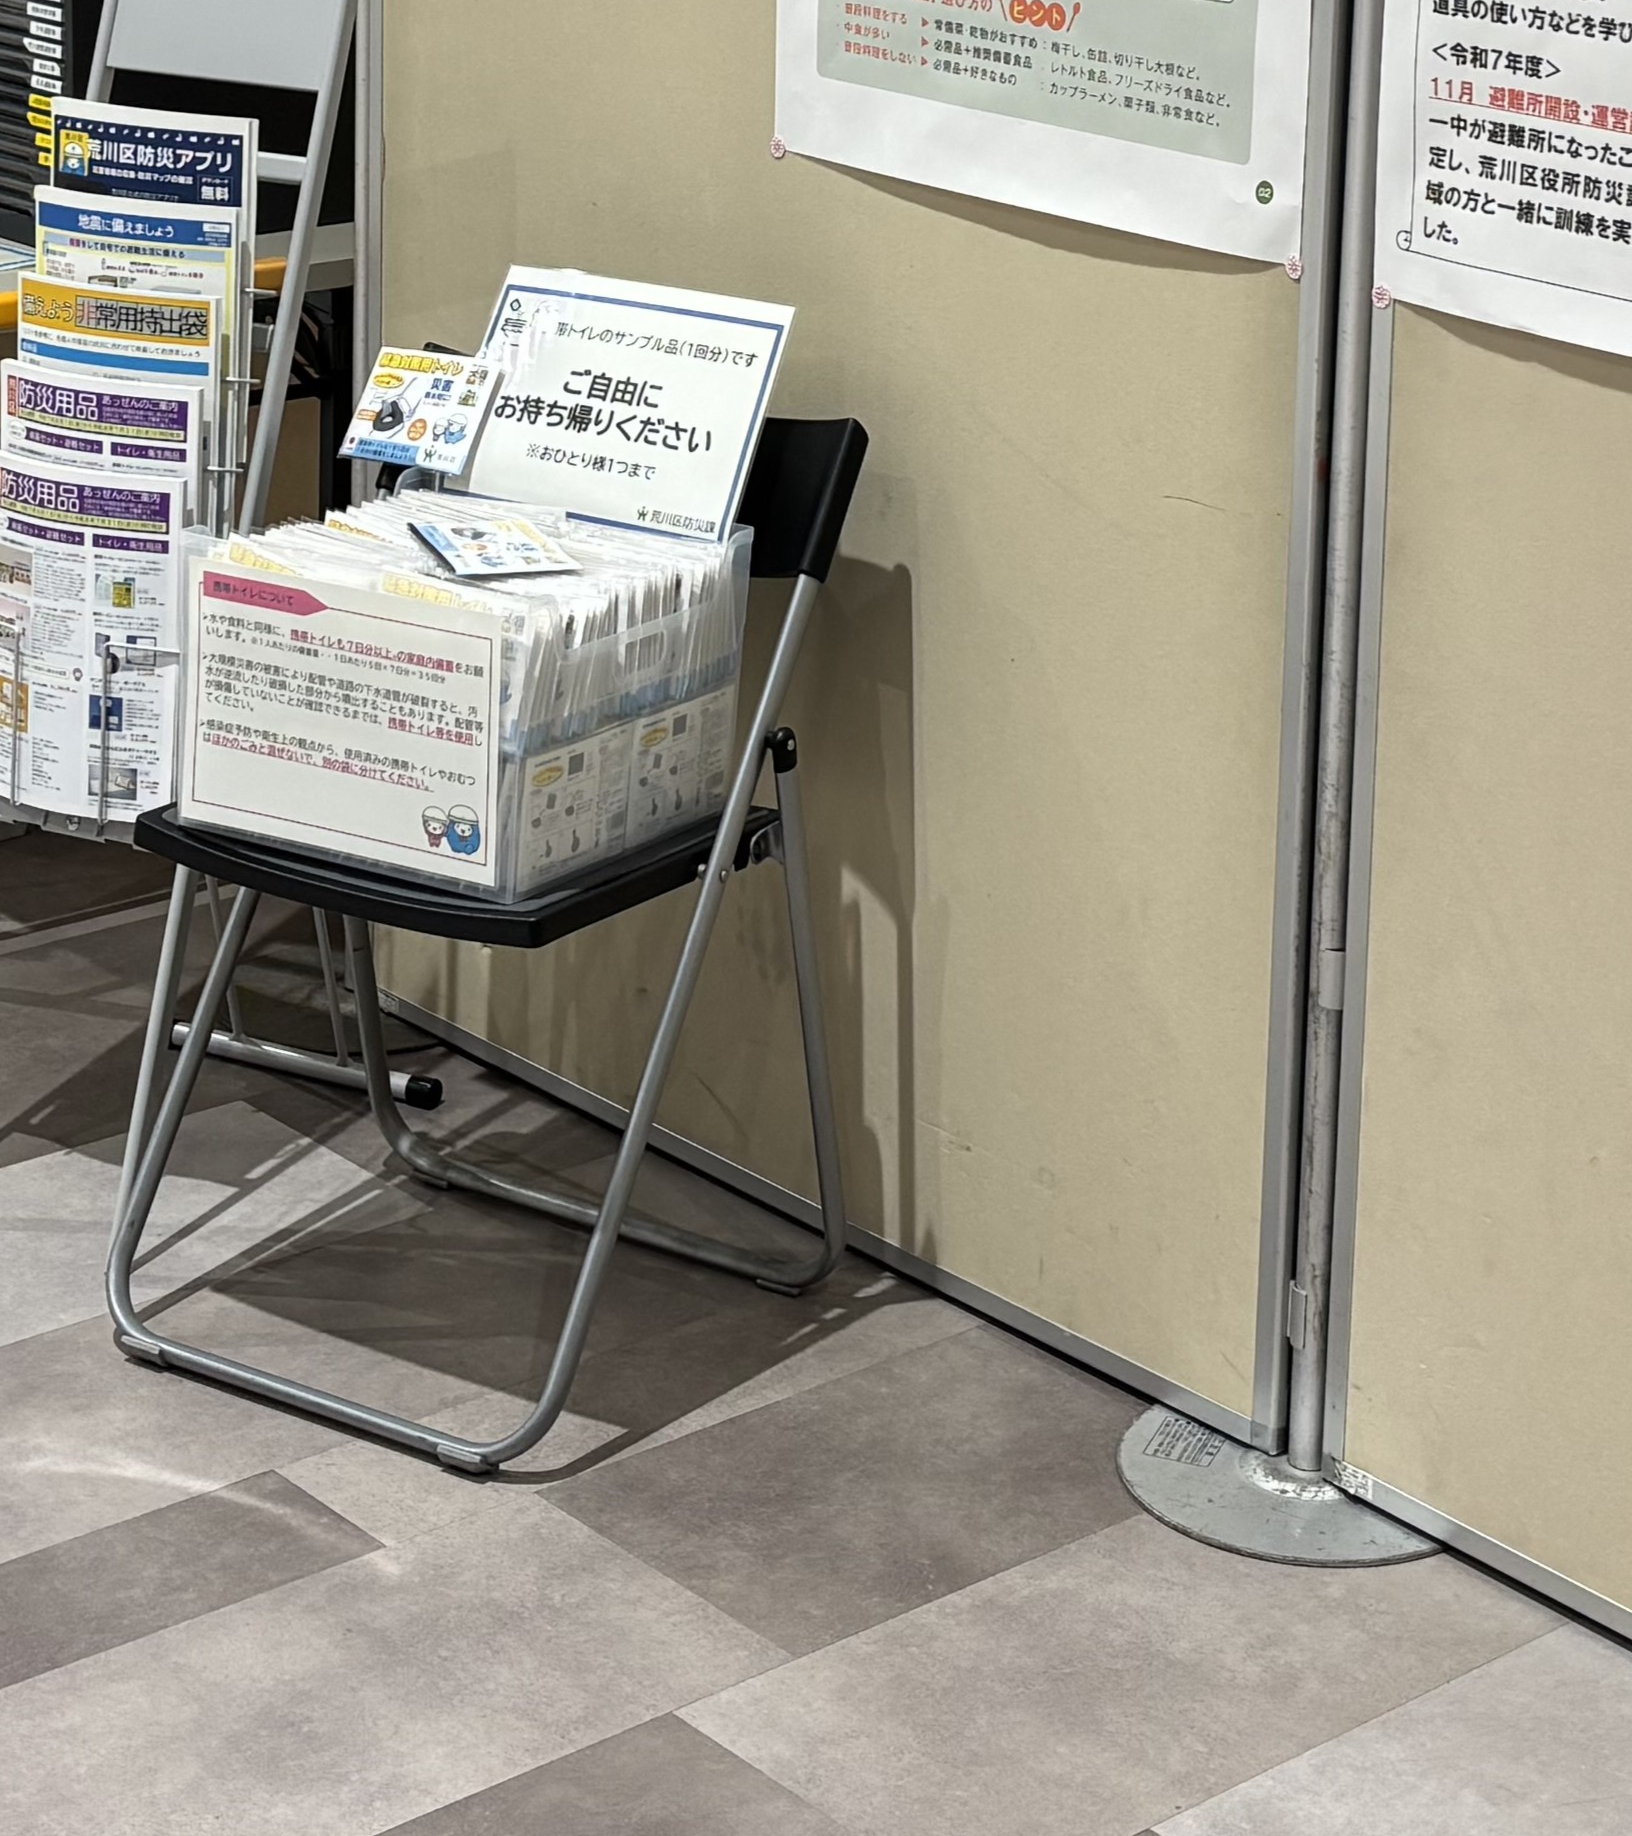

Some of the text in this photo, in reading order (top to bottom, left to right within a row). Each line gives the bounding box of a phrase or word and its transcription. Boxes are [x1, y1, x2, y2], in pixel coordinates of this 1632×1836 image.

[1013, 2, 1064, 27] ヒント
[87, 139, 232, 172] 荒川区防災アプリ
[201, 186, 229, 201] 無料
[78, 214, 174, 237] 地震に備えましょう
[76, 298, 209, 338] 非常用持出袋
[19, 380, 98, 420] 防災用品
[102, 396, 179, 412] あっせんのご案内
[562, 368, 663, 408] ご自由に
[494, 395, 712, 453] お持ち帰りください
[526, 442, 655, 481] ※おひとり様1つまで
[2, 471, 80, 512] 防災用品
[83, 487, 161, 503] あっせんのご案内
[650, 510, 716, 534] 荒川区防災課
